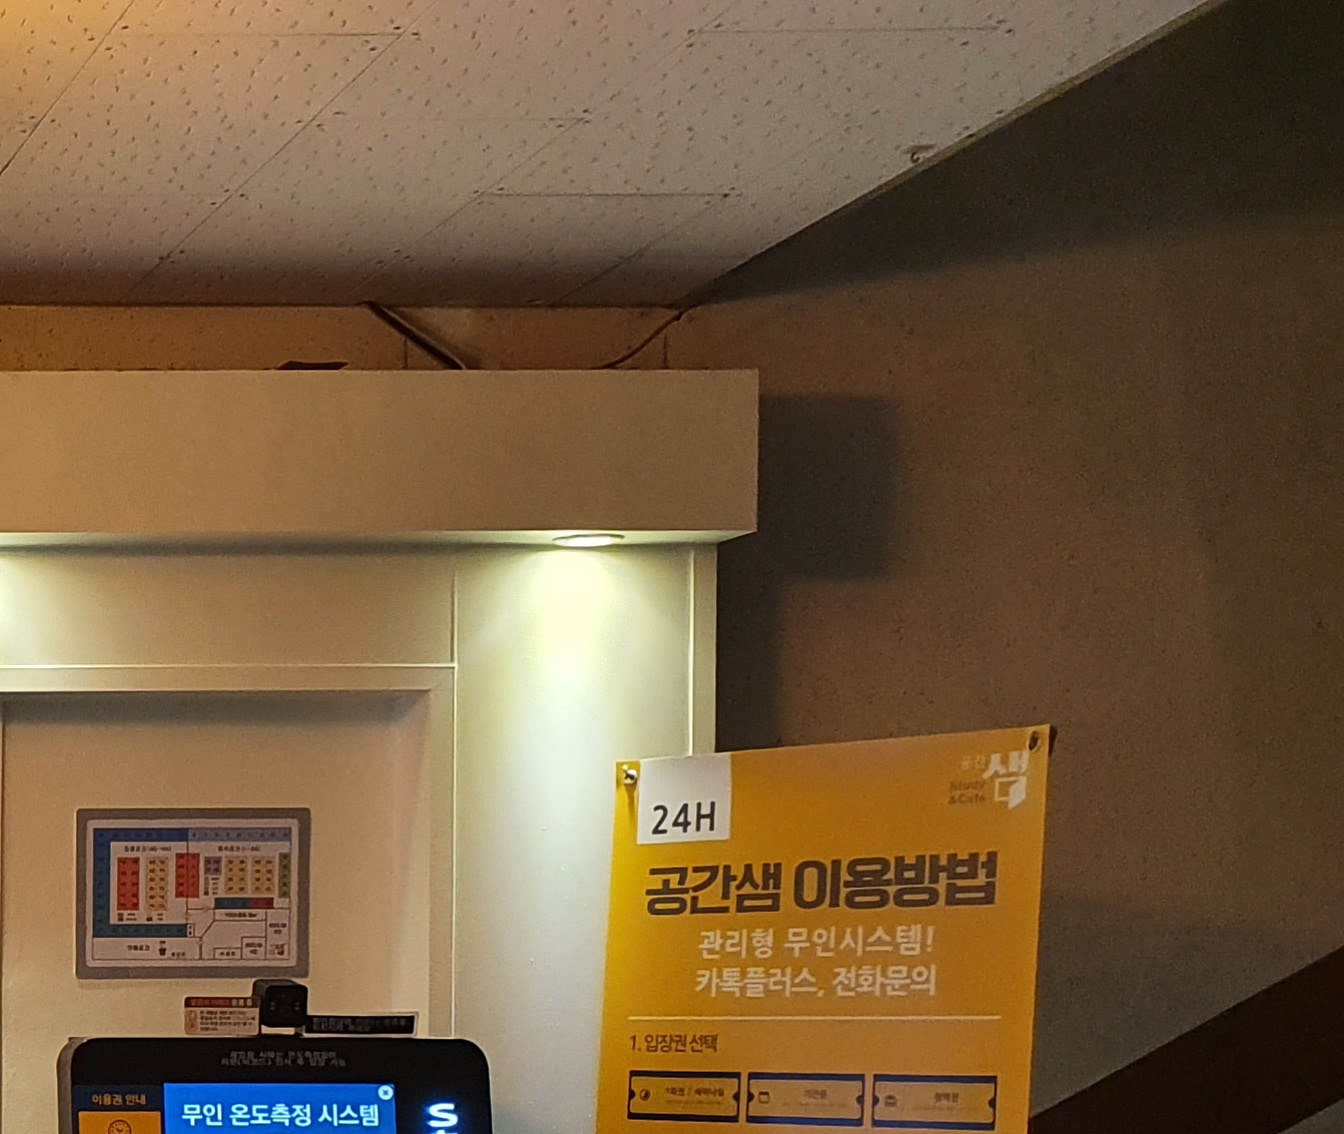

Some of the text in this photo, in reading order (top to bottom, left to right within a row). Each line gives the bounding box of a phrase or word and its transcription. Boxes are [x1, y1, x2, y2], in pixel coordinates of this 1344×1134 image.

[652, 801, 716, 835] 24H
[645, 850, 998, 917] 공간샘 이용방법
[698, 925, 934, 960] 관리형 무인시스템!
[695, 965, 937, 998] 카톡플러스, 전화문의
[644, 1033, 718, 1053] 입장권 선택
[181, 1103, 379, 1127] 무인 온도측정 시스템
